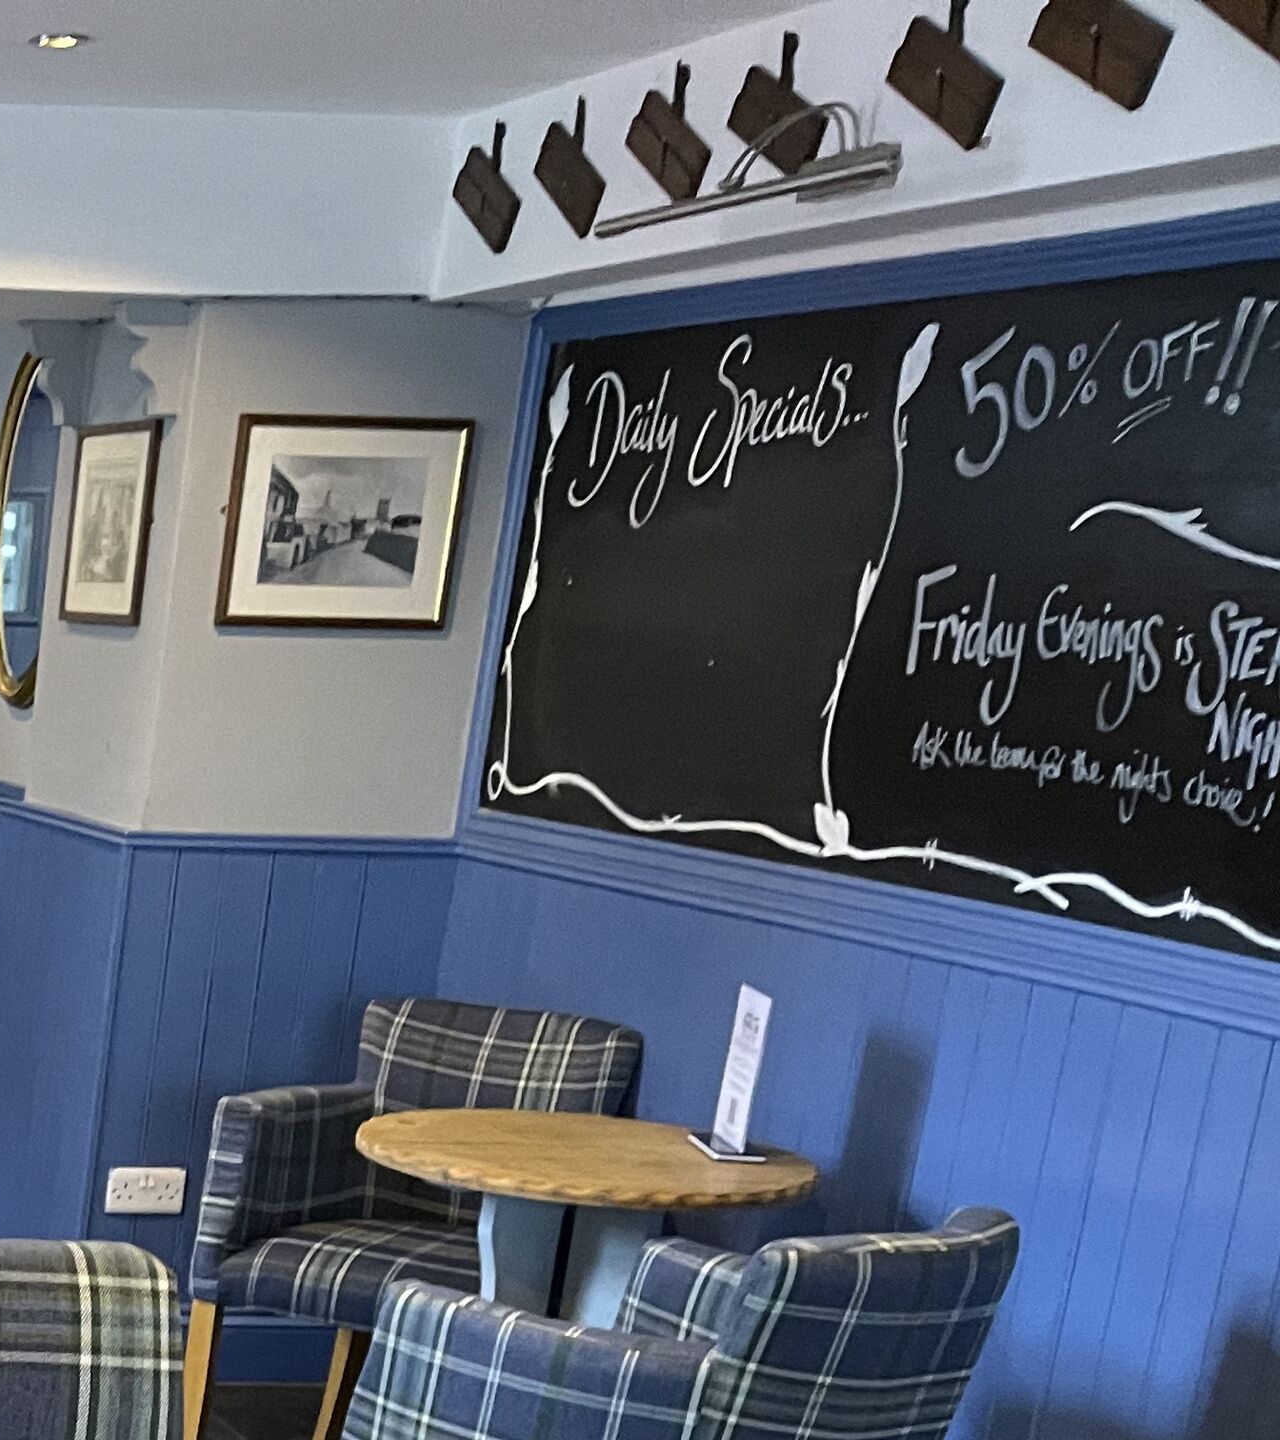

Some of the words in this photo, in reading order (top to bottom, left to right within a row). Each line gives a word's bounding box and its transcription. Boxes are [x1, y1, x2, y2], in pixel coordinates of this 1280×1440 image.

[567, 369, 680, 529] Daily
[954, 318, 1123, 478] 50%
[1123, 297, 1279, 416] OFF!!
[904, 564, 1027, 726] Friday
[1036, 583, 1164, 733] Evenings
[1174, 625, 1194, 667] is
[955, 729, 987, 768] the
[1035, 745, 1067, 788] for
[1070, 749, 1105, 785] the
[1110, 749, 1173, 824] nights
